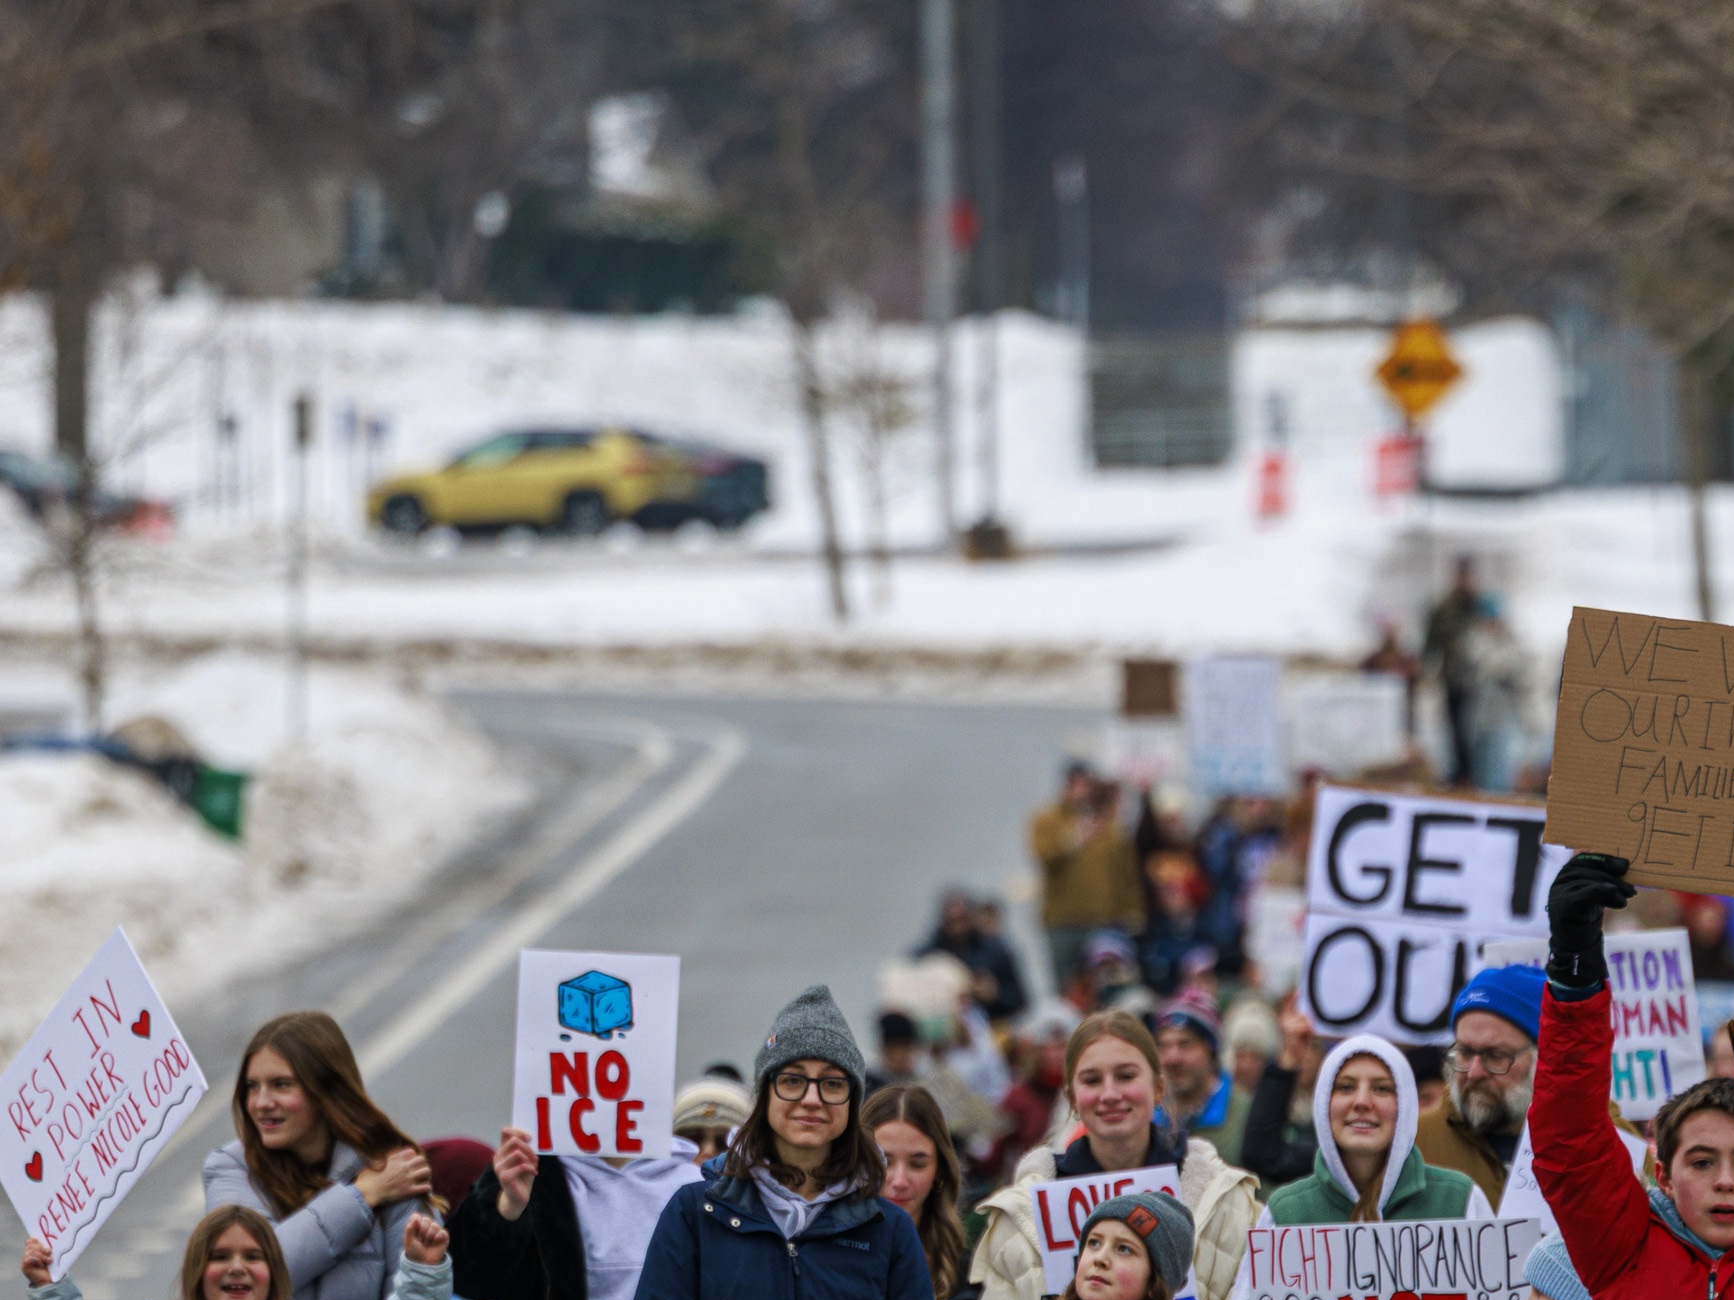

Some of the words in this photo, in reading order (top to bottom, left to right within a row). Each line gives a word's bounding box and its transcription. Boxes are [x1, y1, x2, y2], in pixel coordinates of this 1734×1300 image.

[1582, 616, 1699, 683] WE
[1581, 689, 1689, 747] OUR
[1327, 803, 1546, 918] GET
[1307, 926, 1484, 1031] OU
[8, 1048, 67, 1142] REST
[72, 979, 122, 1060] IN
[549, 1050, 630, 1102] NO
[38, 1160, 96, 1249] RENEE
[91, 1092, 147, 1176] NICOLE
[143, 1039, 190, 1108] GOOD
[47, 1052, 124, 1162] POWER
[536, 1097, 645, 1155] ICE
[1248, 1228, 1341, 1295] FIGHT
[1345, 1219, 1532, 1293] IGNORANCE
